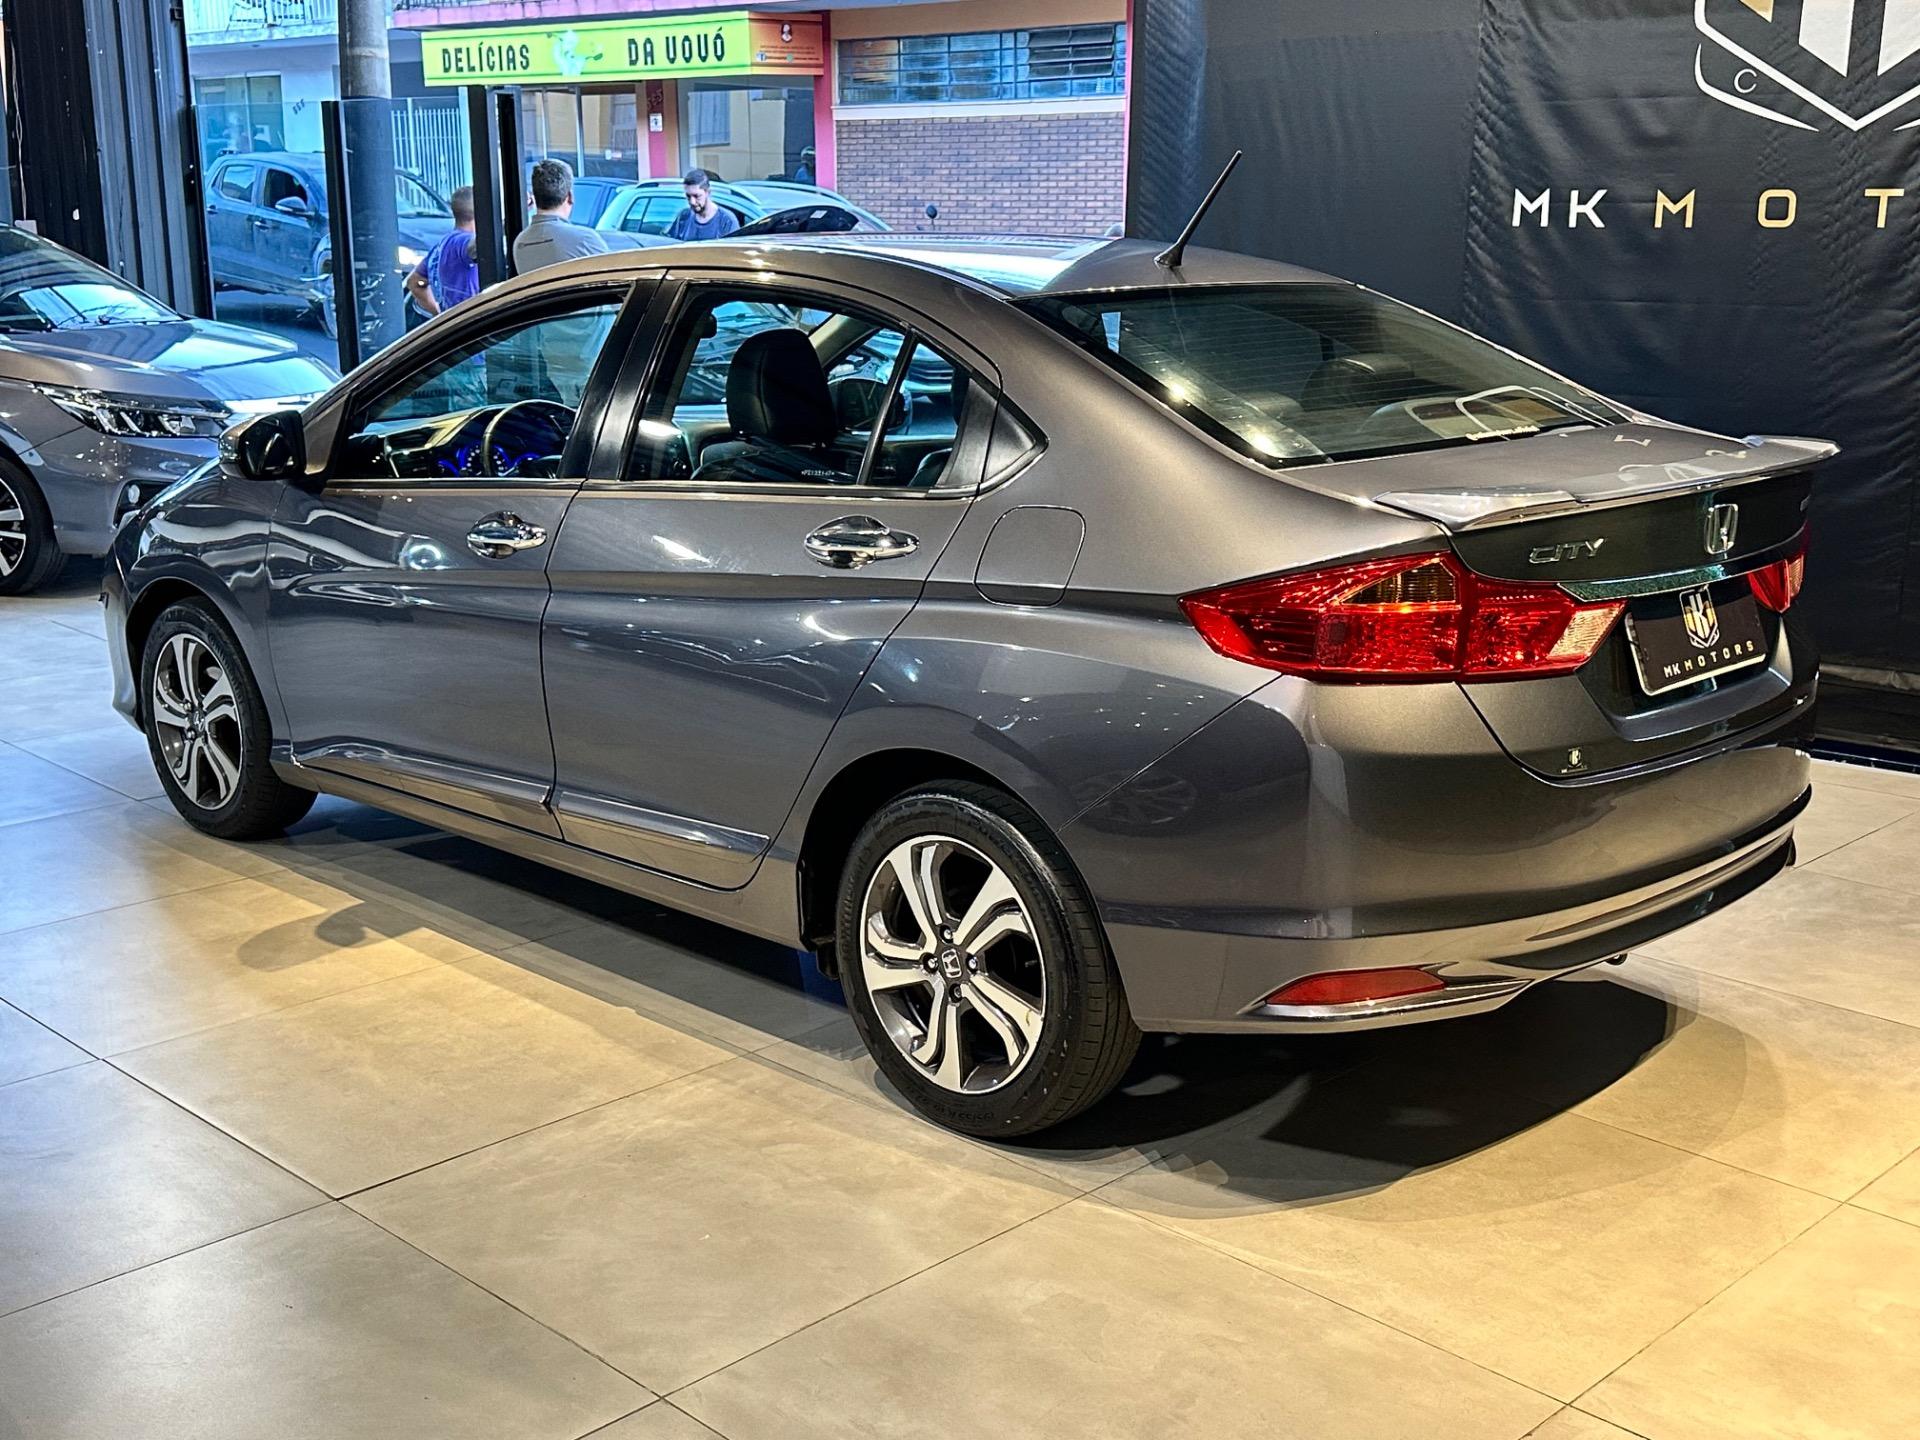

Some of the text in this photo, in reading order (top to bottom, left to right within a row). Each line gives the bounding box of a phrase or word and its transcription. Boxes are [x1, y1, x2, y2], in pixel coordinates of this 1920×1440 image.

[442, 41, 530, 73] DELÍCIAS
[627, 37, 655, 66] DA
[1511, 188, 1608, 228] MK
[1529, 538, 1604, 564] CITY
[1663, 640, 1754, 678] MK MOTORS
